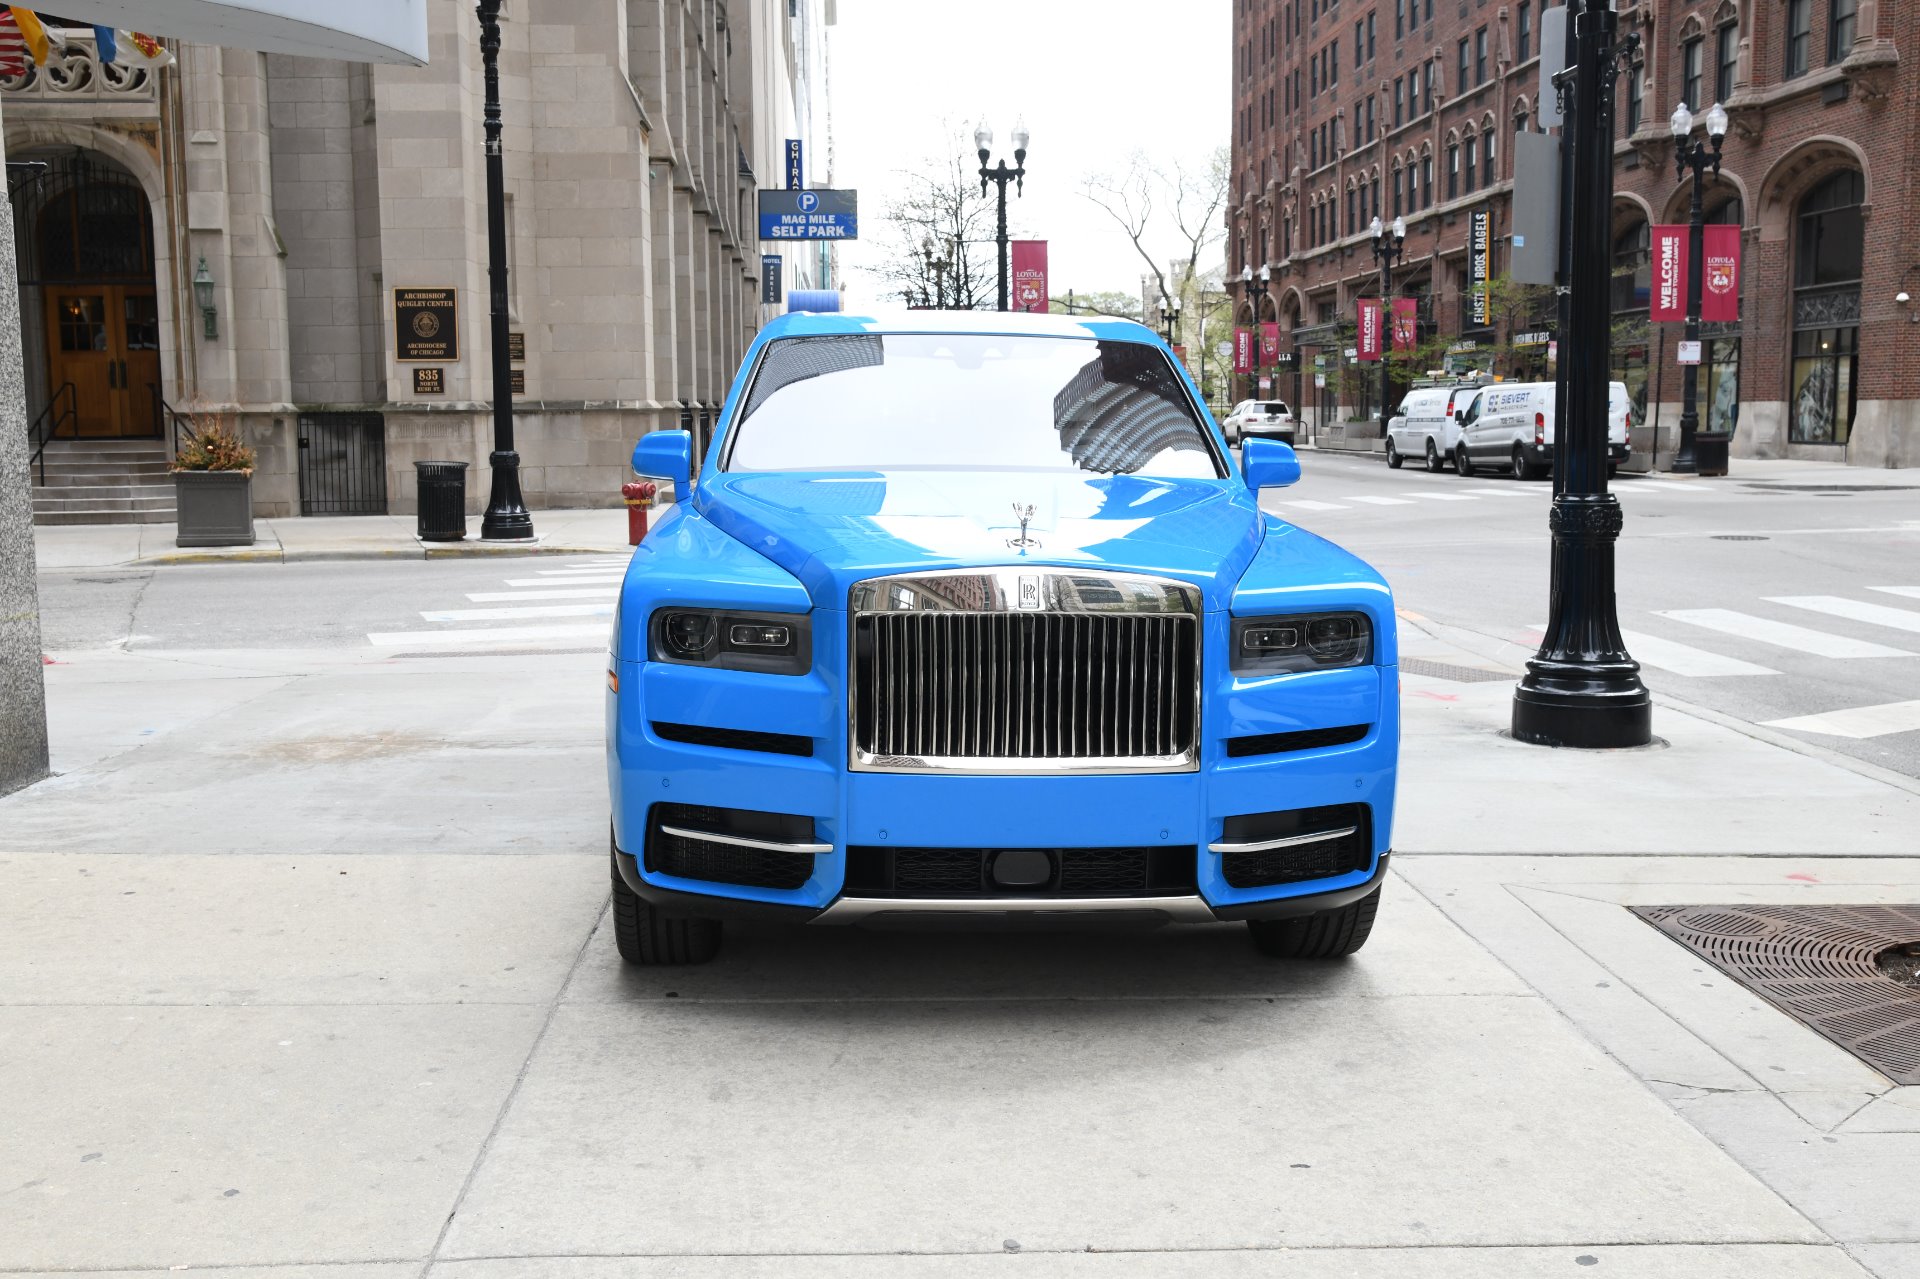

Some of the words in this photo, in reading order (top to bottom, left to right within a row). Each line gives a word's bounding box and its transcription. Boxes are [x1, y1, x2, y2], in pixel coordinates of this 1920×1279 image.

[803, 195, 815, 210] P
[781, 215, 806, 224] MAG
[808, 215, 836, 224] MILE
[771, 226, 805, 237] SELF
[808, 226, 846, 237] PARK
[1475, 213, 1487, 250] BAGELS
[1707, 256, 1735, 264] LOYOLA
[1660, 236, 1673, 310] WELCOME
[397, 300, 426, 308] QUIGLEY
[1363, 306, 1372, 353] WELCOME
[418, 370, 438, 380] 835
[1501, 392, 1531, 404] SIEVERT
